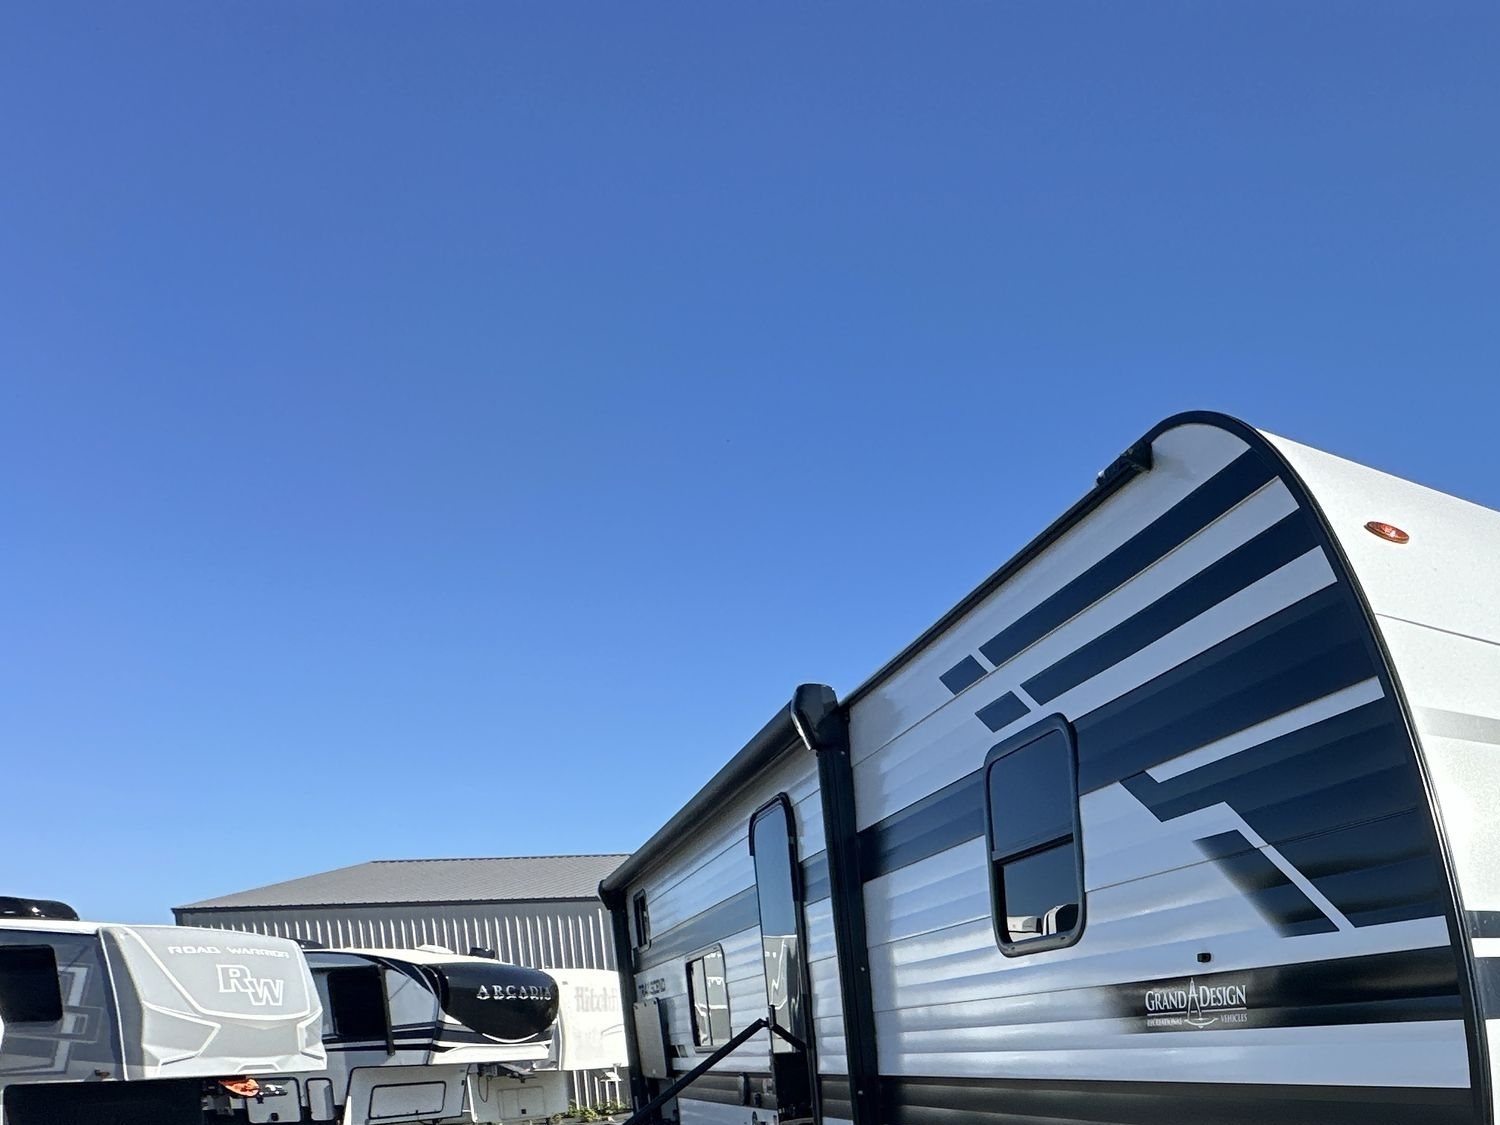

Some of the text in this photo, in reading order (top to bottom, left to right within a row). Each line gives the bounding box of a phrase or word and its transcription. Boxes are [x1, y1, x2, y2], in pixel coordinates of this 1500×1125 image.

[168, 946, 289, 959] ROAD WARRIOR
[476, 984, 552, 1000] ARCADIA
[1145, 984, 1247, 1011] GRAND DESIGN
